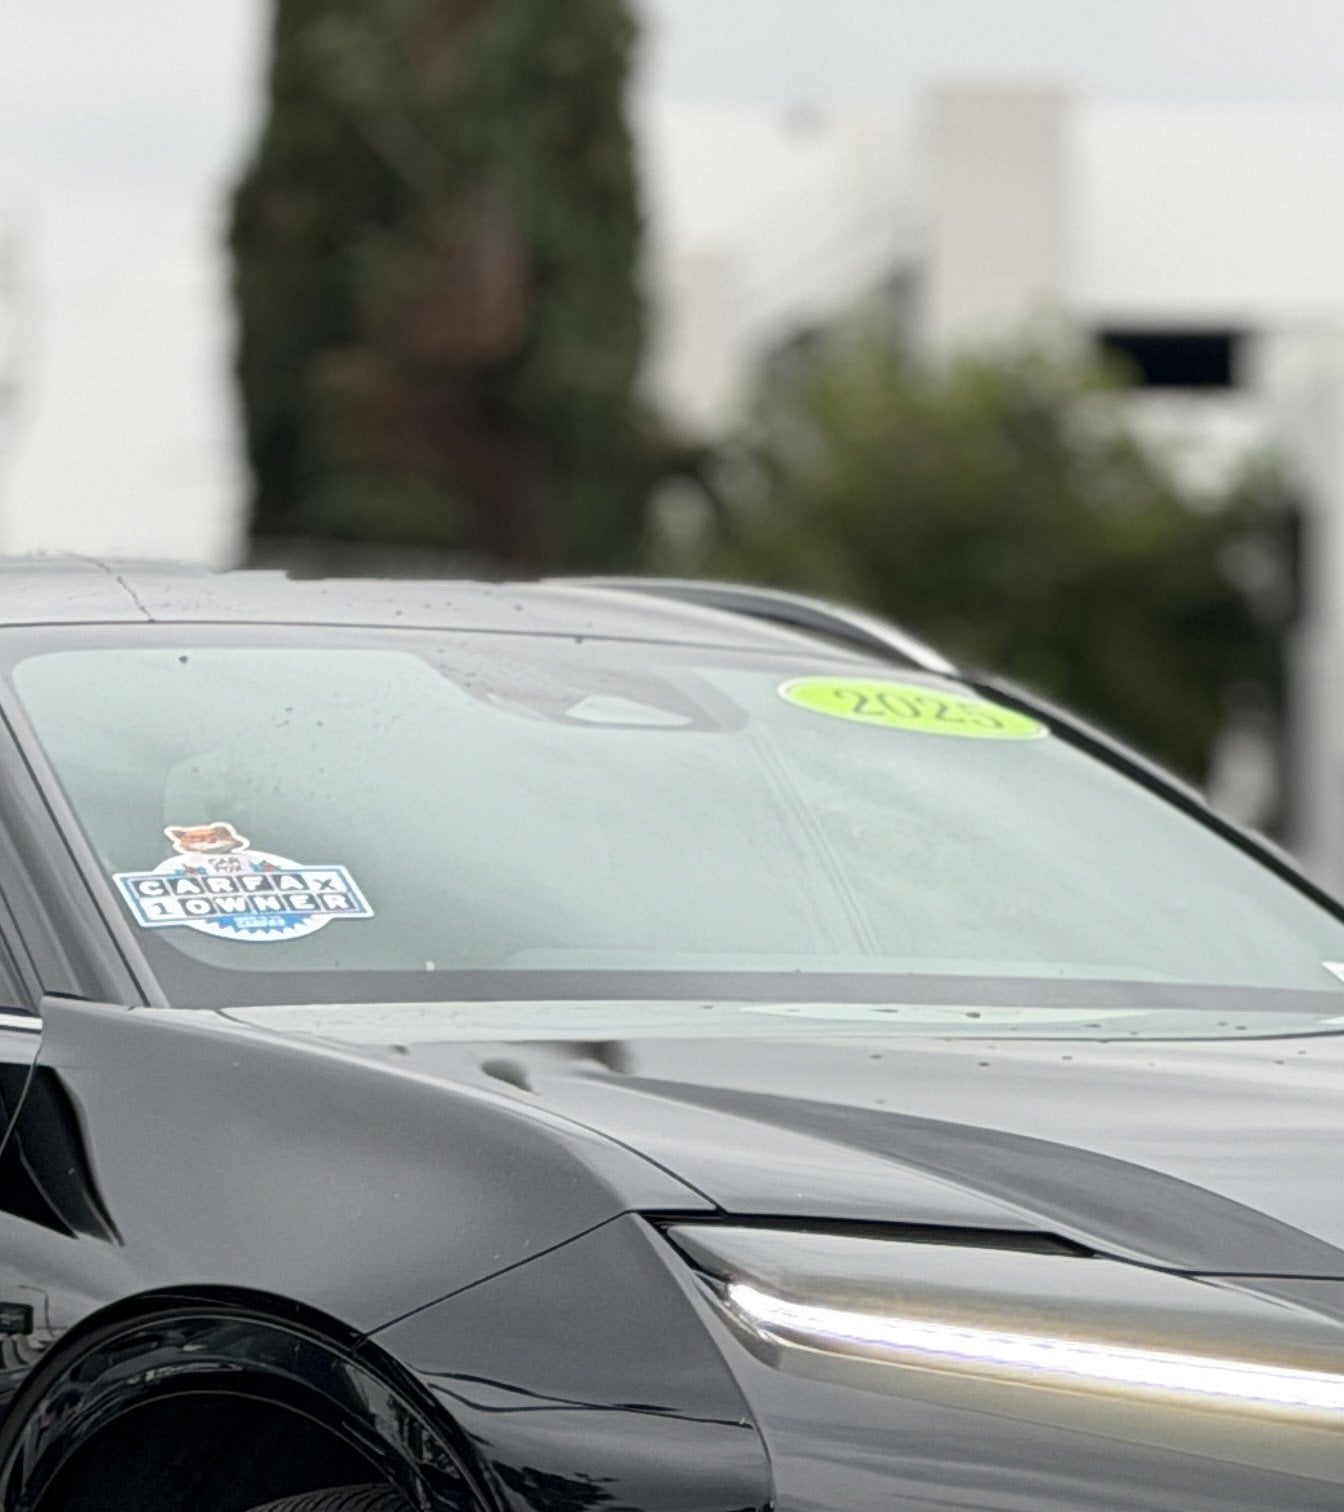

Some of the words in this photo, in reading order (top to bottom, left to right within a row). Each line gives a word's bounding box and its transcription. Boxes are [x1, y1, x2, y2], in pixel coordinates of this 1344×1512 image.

[139, 875, 340, 896] CARFAX
[154, 898, 174, 915] 1
[187, 894, 350, 915] OWNER
